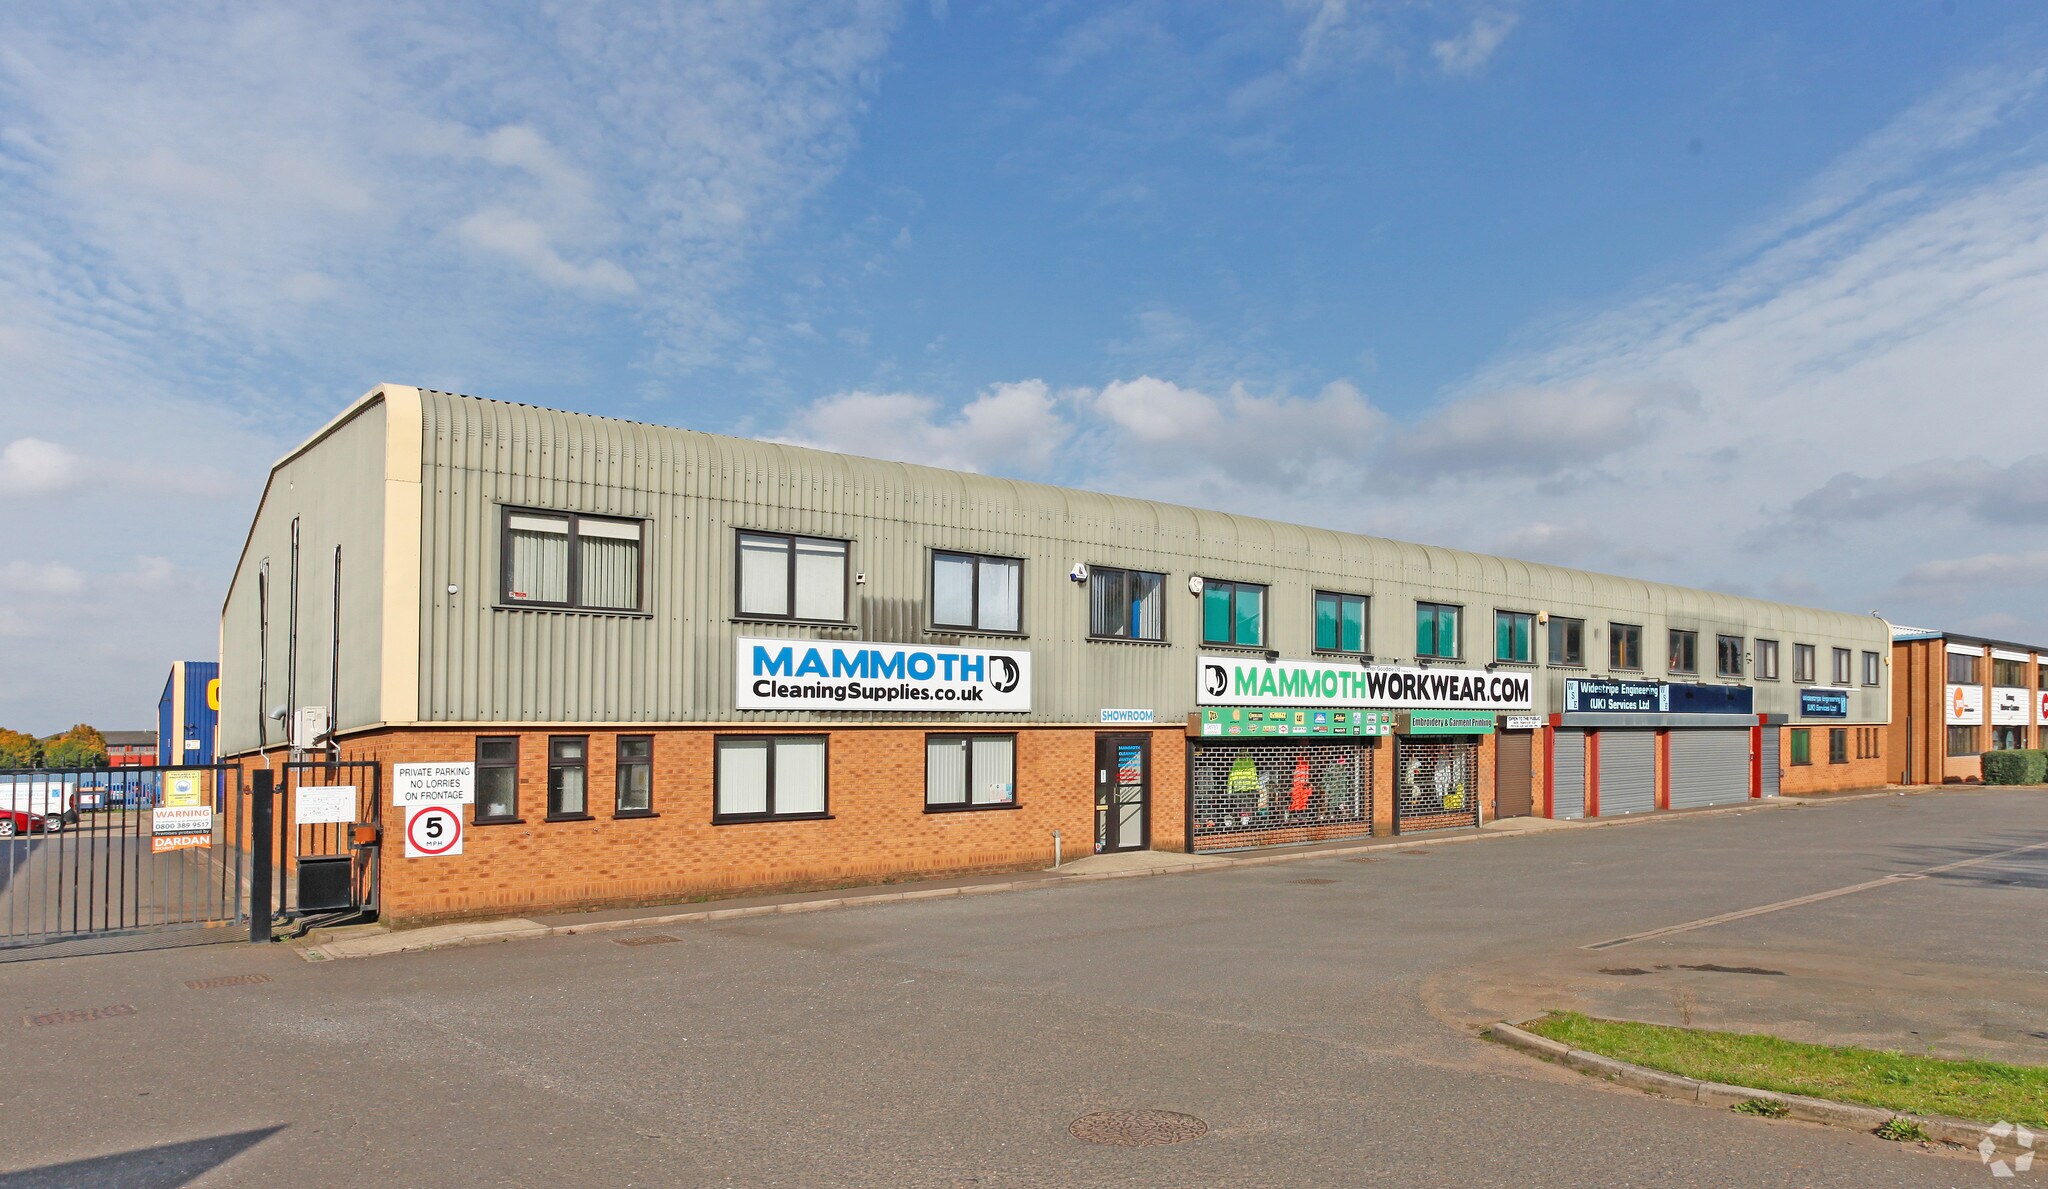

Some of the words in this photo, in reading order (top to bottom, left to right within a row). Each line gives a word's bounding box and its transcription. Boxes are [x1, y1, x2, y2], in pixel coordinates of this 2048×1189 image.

[753, 645, 985, 682] MAMMOTH
[753, 680, 984, 702] CleaningSupplies.co.uk
[1580, 681, 1619, 696] Widestripe
[1621, 683, 1658, 698] Engineering
[1590, 698, 1606, 709] (UK)
[1608, 698, 1637, 710] Services
[1638, 699, 1650, 710] Ltd
[1102, 710, 1153, 721] SHOWROOM
[1412, 717, 1444, 727] Embroidery
[1449, 718, 1471, 727] Garment
[1472, 718, 1492, 728] Printing
[399, 767, 432, 777] PRIVATE
[435, 767, 471, 776] PARKING
[410, 779, 423, 788] NO
[426, 779, 461, 788] LORRIES
[405, 792, 418, 801] ON
[420, 791, 463, 800] FRONTAGE
[155, 810, 210, 818] WARNING
[426, 816, 443, 839] 5
[155, 836, 210, 847] DARDAN
